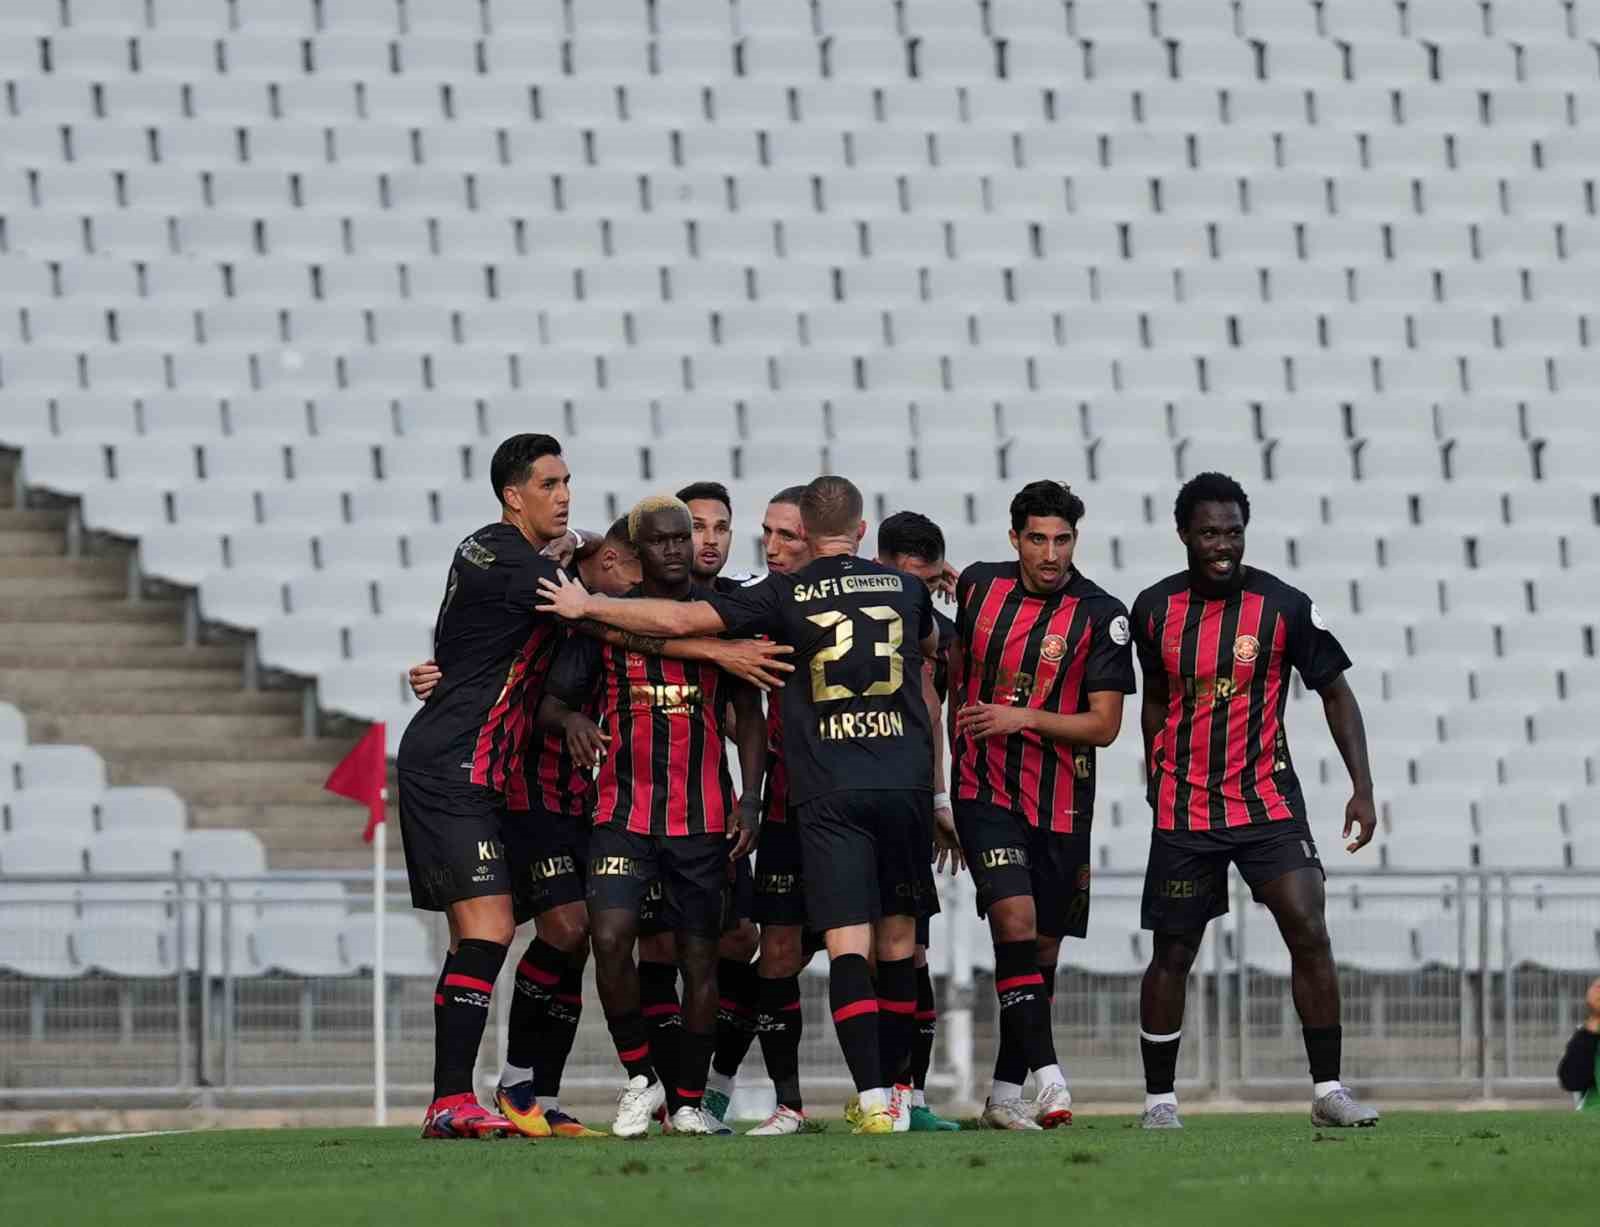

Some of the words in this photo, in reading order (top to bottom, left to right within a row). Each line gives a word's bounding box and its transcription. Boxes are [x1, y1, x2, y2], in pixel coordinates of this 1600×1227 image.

[806, 605, 904, 703] 23
[819, 711, 904, 741] LARSSON
[981, 847, 1026, 869] UZEN
